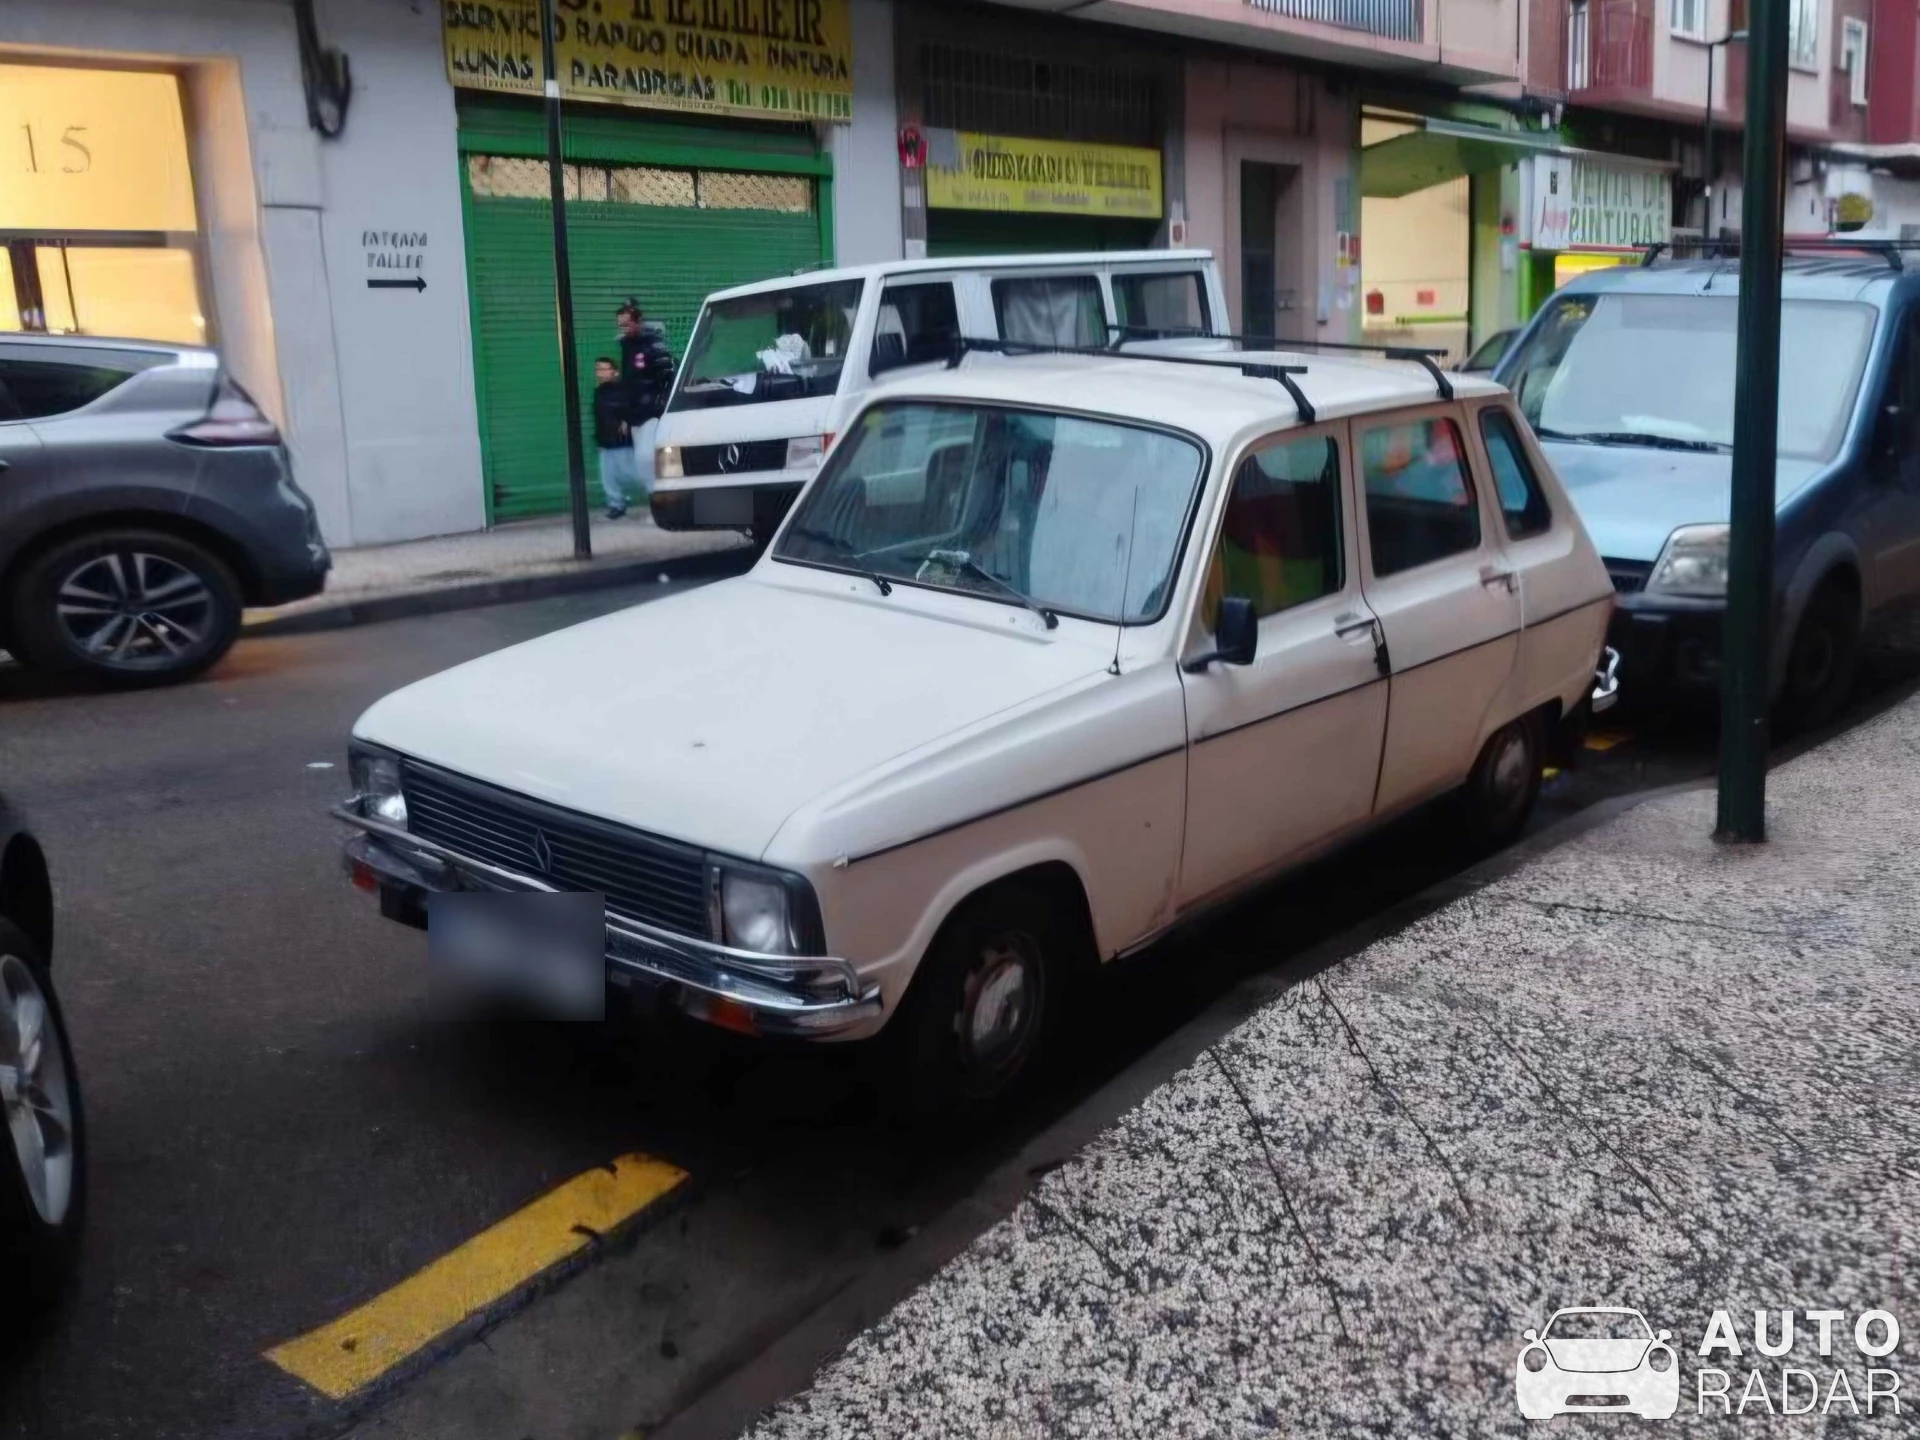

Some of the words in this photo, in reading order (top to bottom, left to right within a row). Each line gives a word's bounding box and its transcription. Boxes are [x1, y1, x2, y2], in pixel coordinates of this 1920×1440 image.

[446, 2, 566, 42] SERVICO
[453, 45, 533, 80] LUNAS
[20, 123, 92, 174] 15
